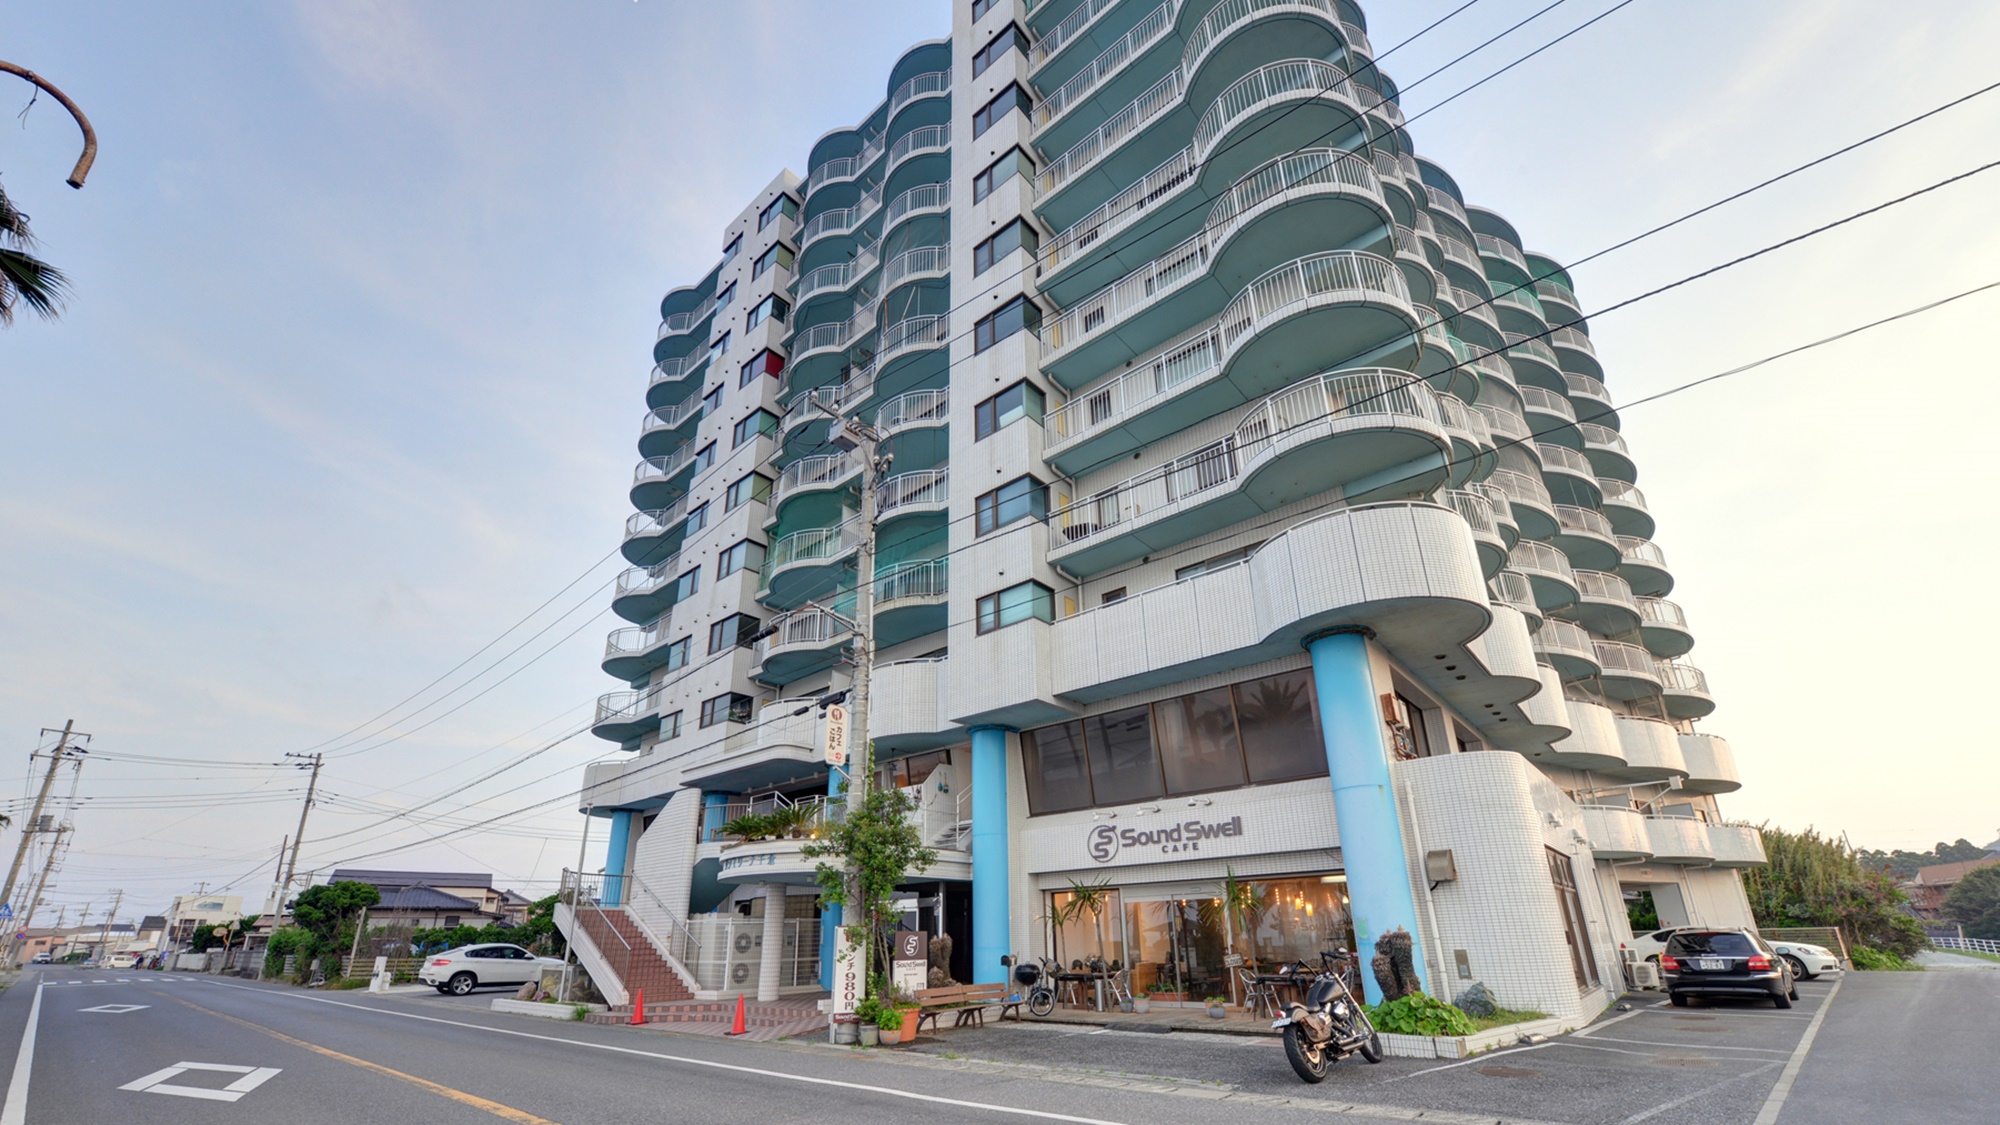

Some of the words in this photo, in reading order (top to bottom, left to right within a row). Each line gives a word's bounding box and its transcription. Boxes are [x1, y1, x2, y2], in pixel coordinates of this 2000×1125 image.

[1120, 823, 1182, 847] Sound
[1184, 816, 1243, 841] Swell
[1161, 842, 1200, 853] CAFE
